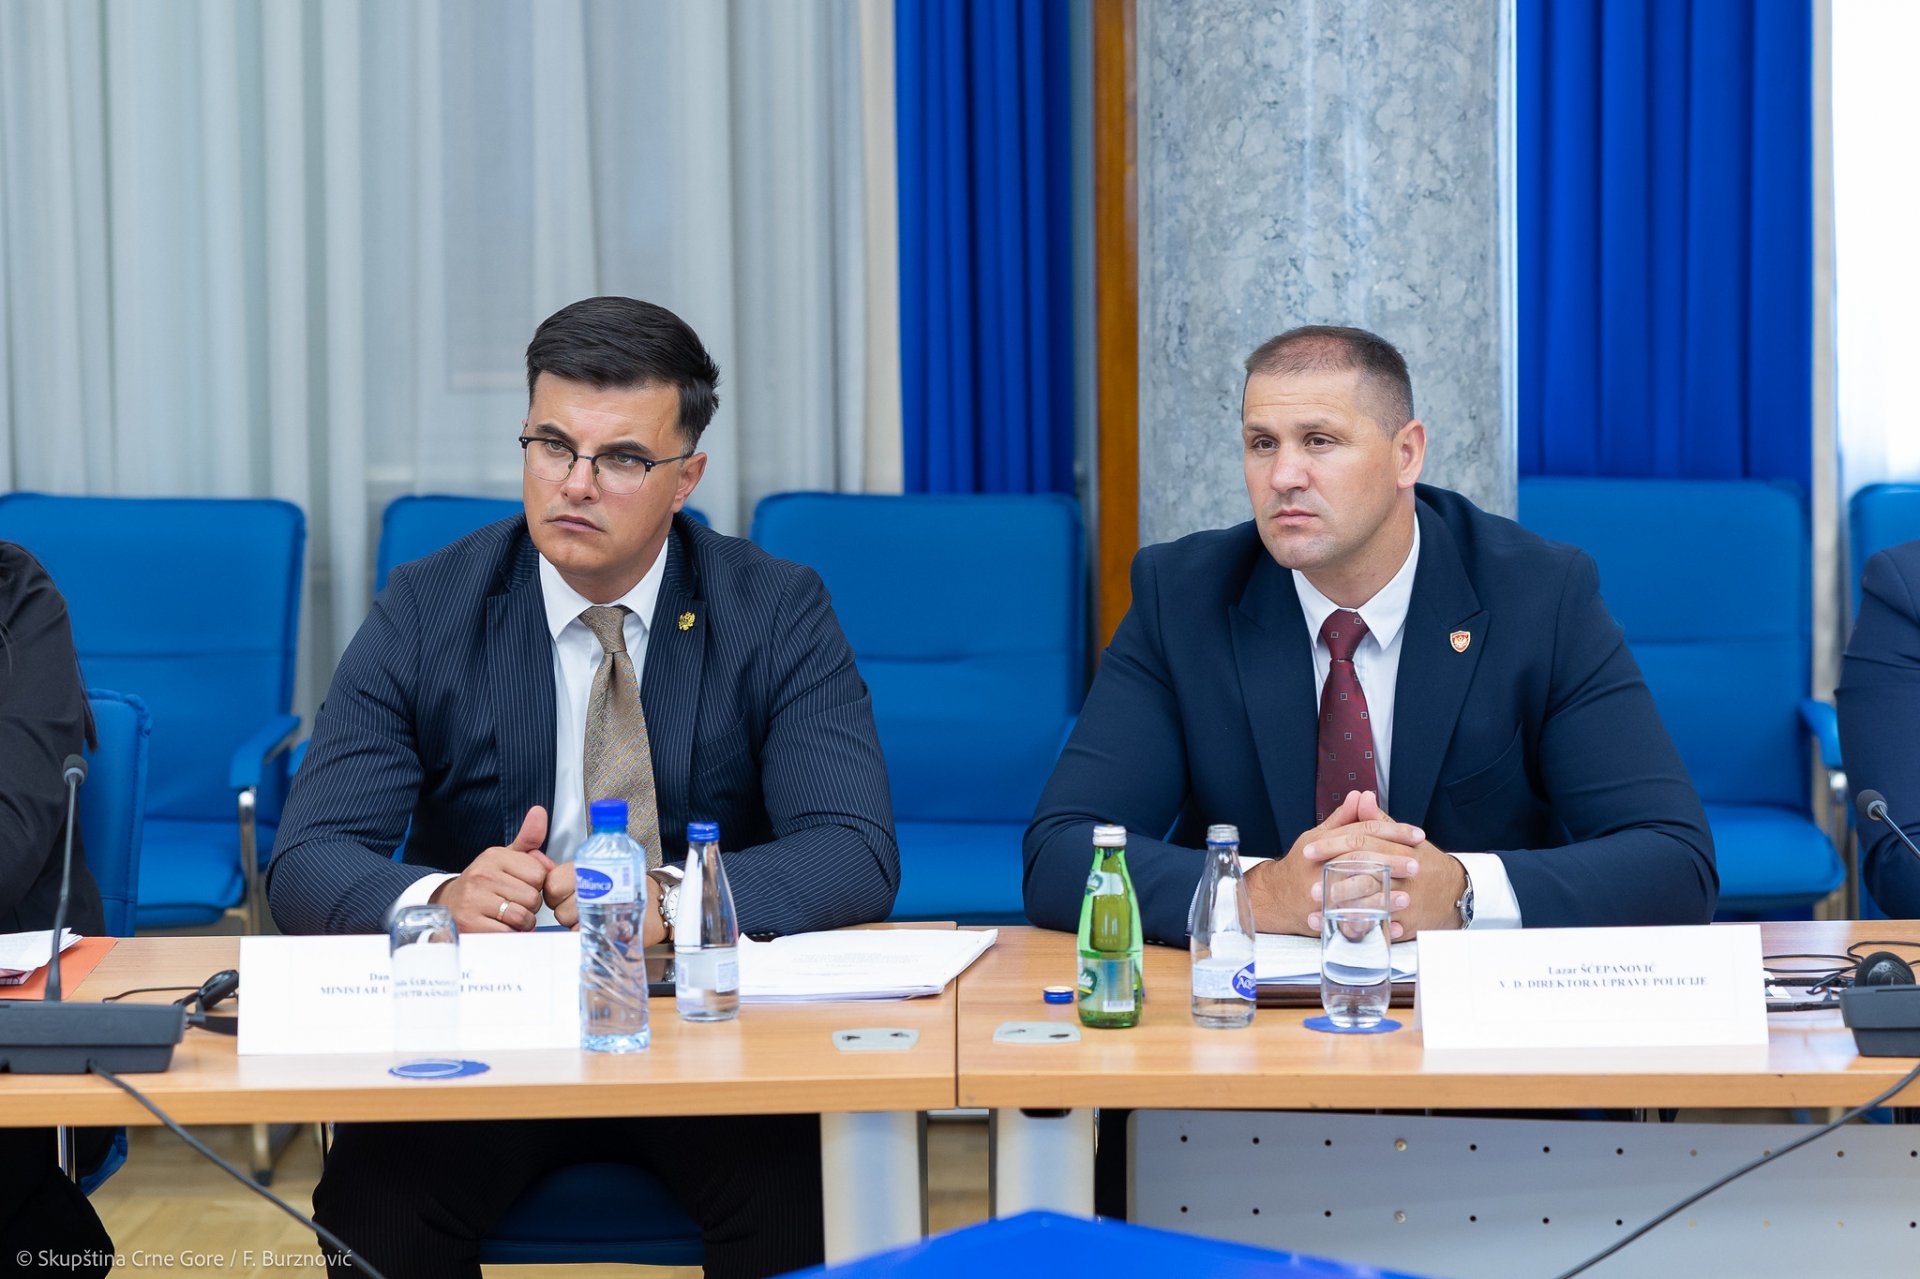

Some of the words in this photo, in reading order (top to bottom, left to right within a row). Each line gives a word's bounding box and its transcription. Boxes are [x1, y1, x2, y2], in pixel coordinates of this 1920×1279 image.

[1548, 966, 1577, 975] Lazar
[320, 985, 379, 995] MINISTAR
[467, 982, 524, 992] POSLOVA
[1528, 979, 1598, 989] DIREKTORA
[1602, 978, 1649, 987] UPRAVE
[1653, 976, 1708, 987] POLICIJE
